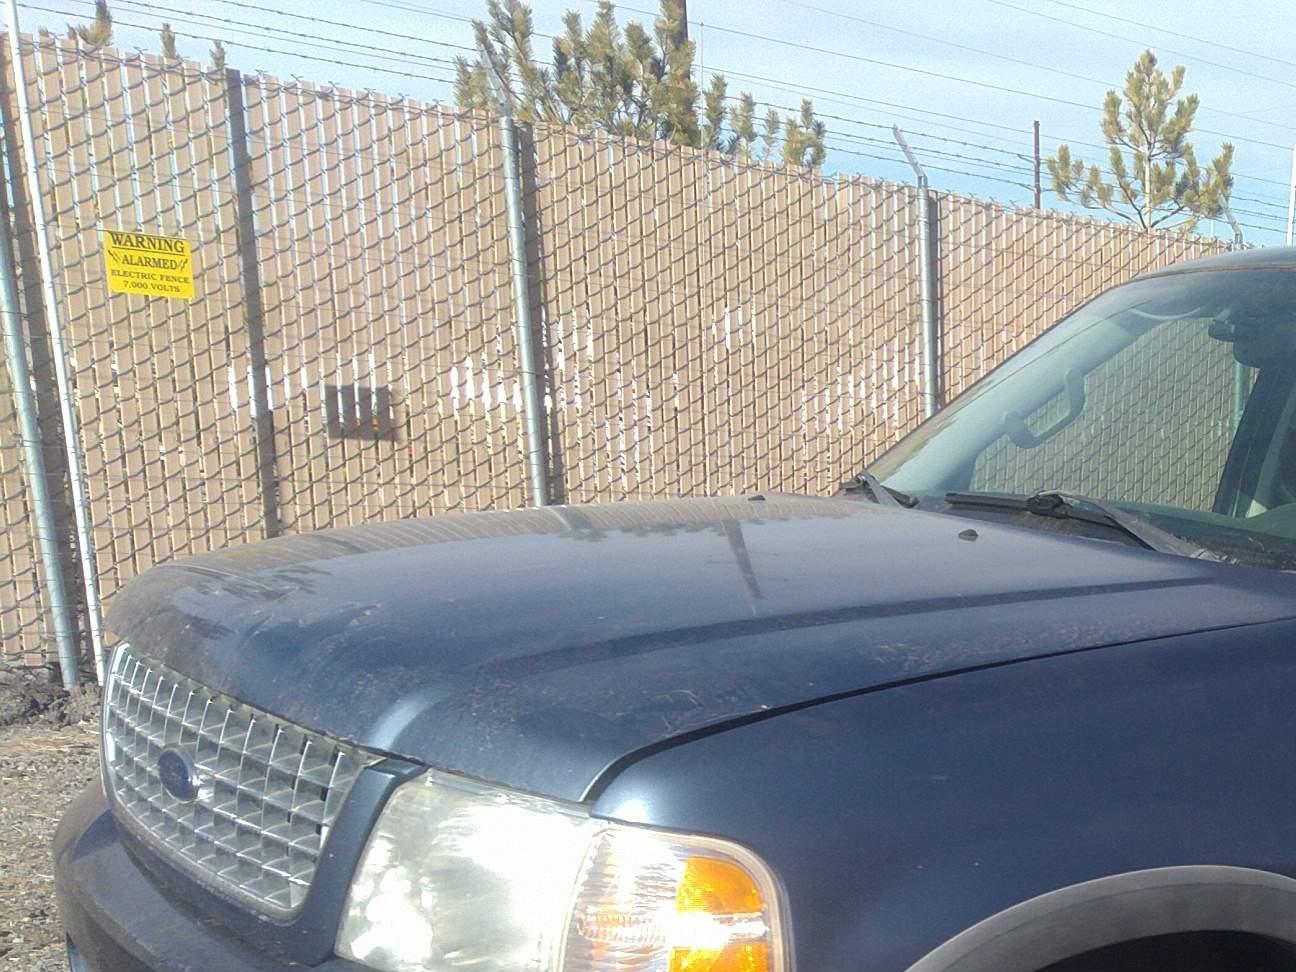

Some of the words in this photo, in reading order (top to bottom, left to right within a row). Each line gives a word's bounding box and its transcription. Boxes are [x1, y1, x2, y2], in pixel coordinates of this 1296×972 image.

[109, 232, 185, 253] WARNING
[122, 254, 178, 270] ALARMED
[111, 269, 158, 281] ELECTRIC
[160, 273, 190, 284] FENCE
[150, 283, 181, 293] VOLTS
